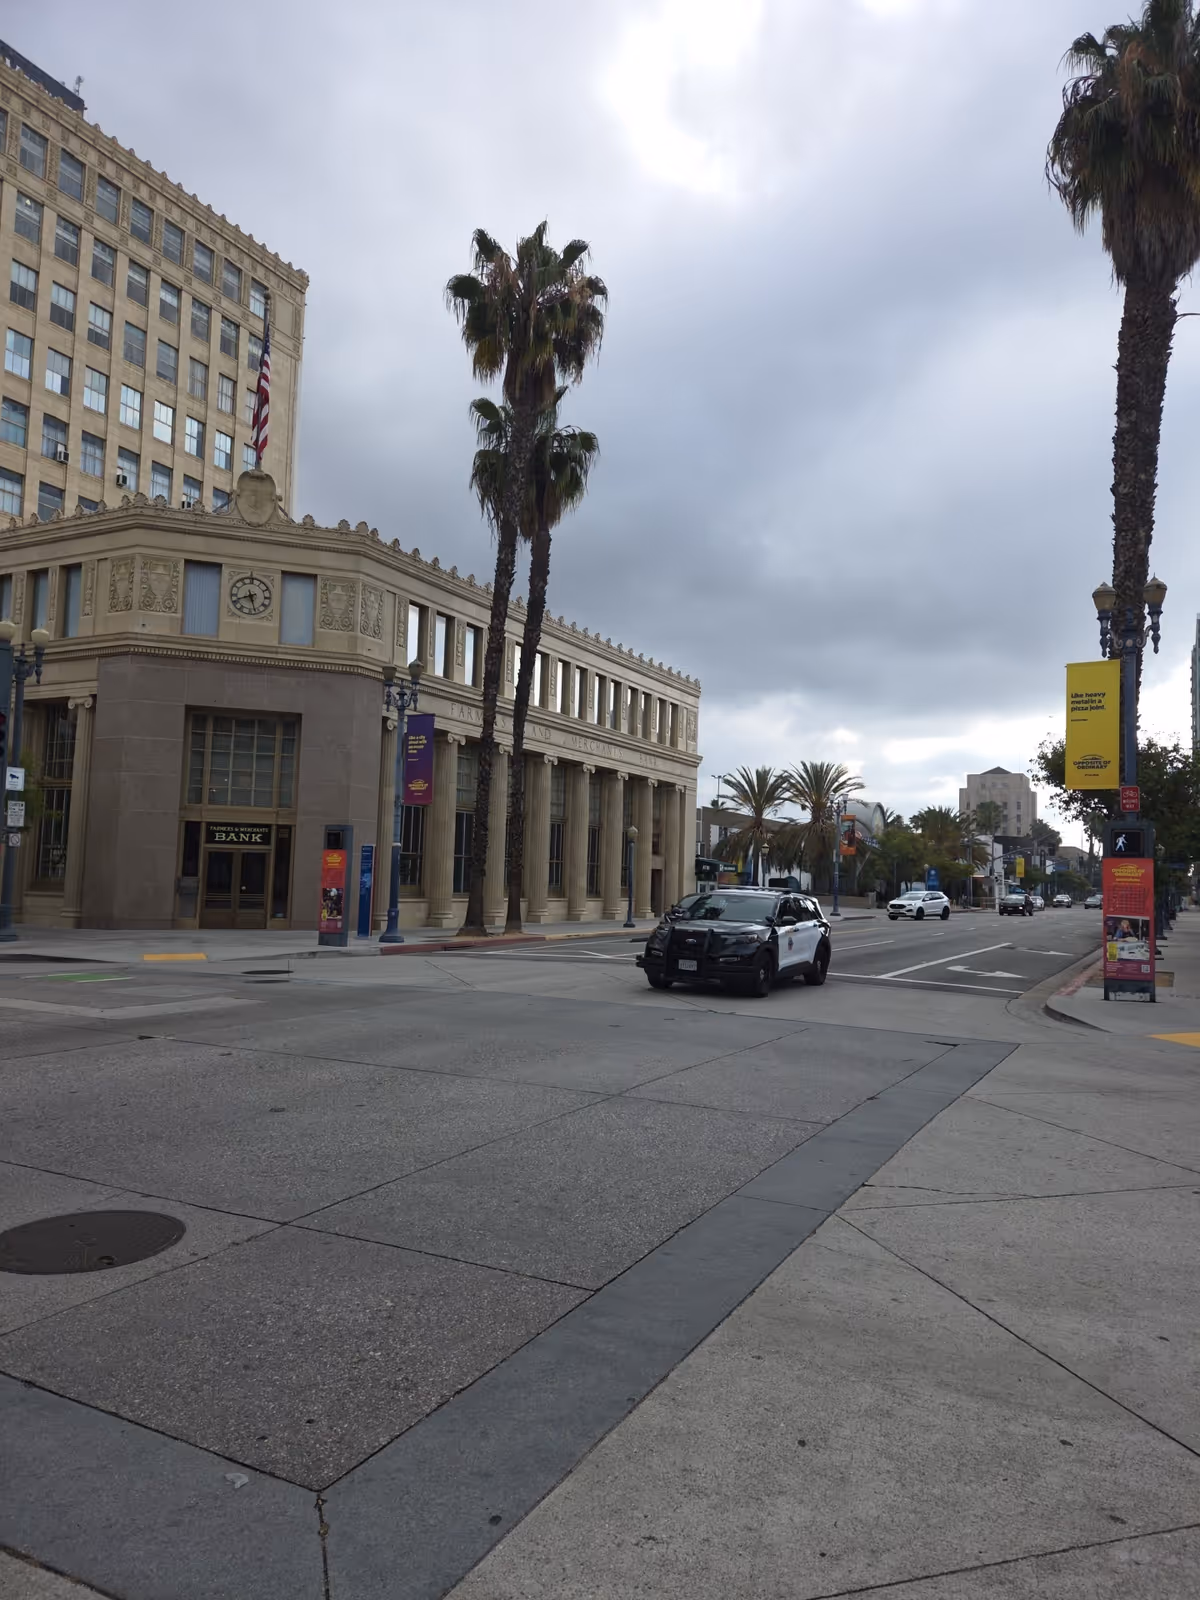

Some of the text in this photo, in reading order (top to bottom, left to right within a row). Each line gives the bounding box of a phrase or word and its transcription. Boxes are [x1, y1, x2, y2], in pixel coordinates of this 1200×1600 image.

[531, 725, 552, 740] AND
[571, 736, 624, 760] MERCHANTS
[214, 832, 263, 842] BANK
